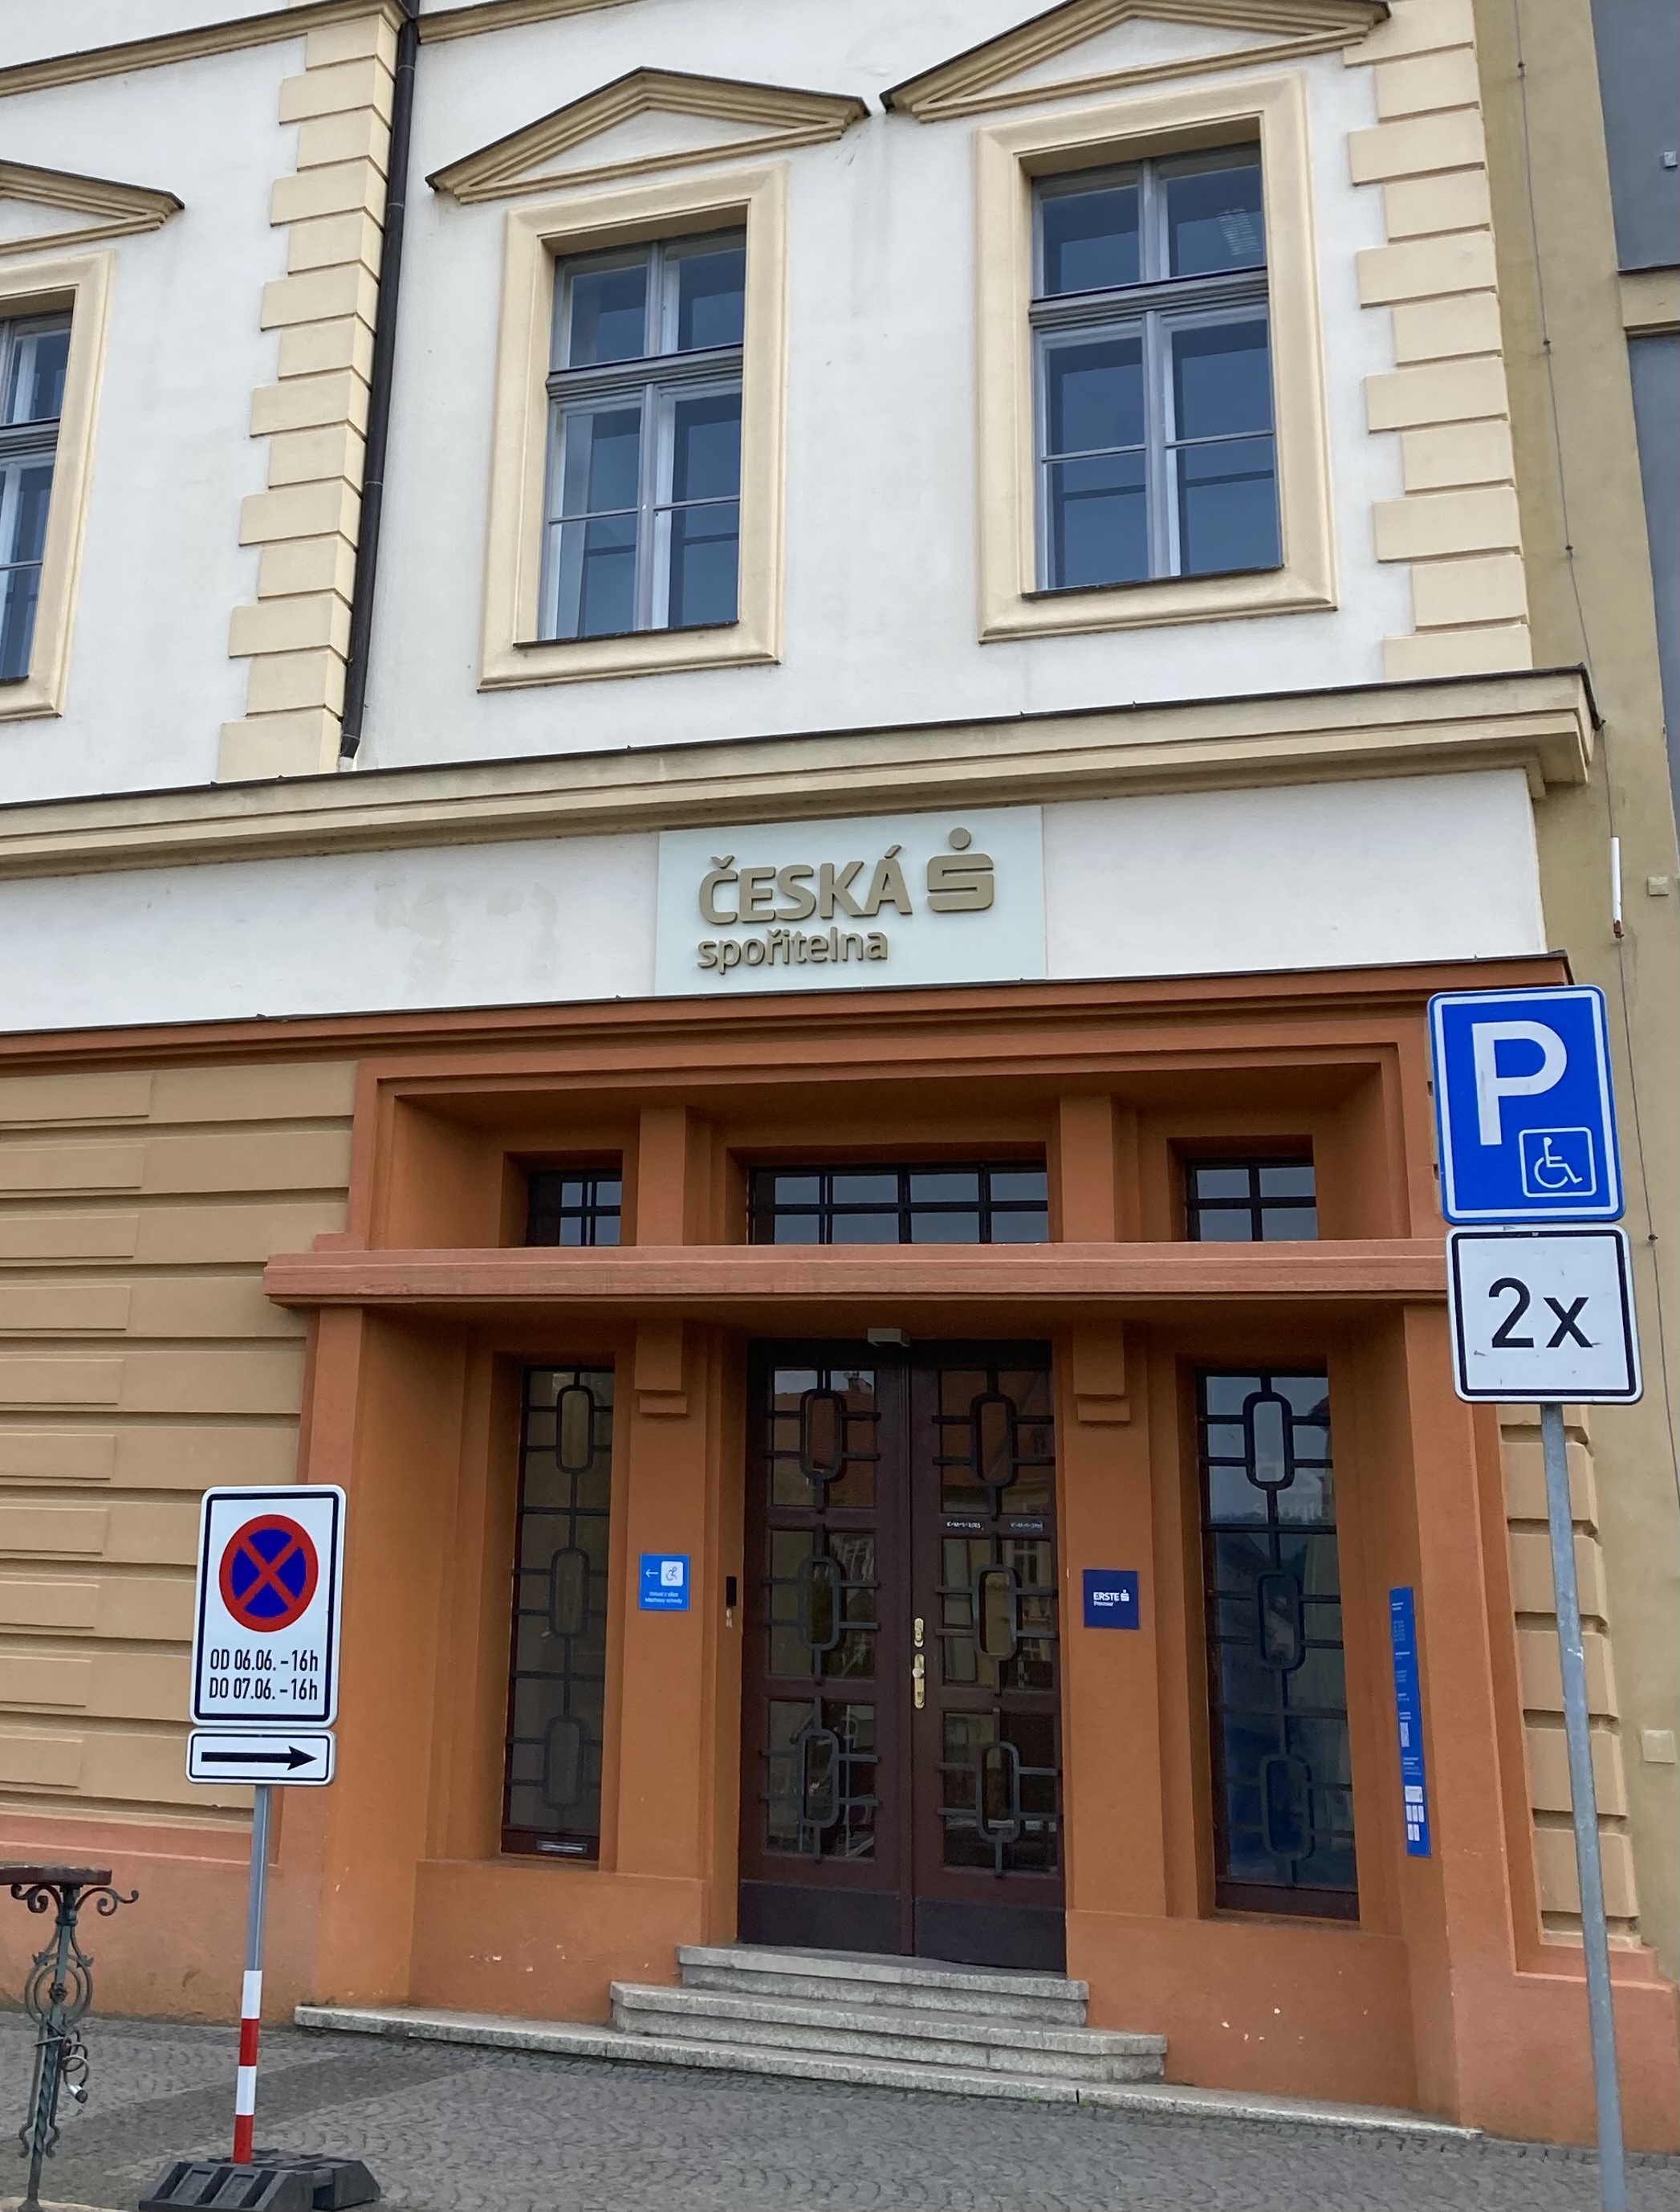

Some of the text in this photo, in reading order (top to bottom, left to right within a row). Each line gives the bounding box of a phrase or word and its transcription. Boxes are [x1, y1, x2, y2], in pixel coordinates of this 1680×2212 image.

[699, 845, 913, 924] ČESKÁ
[698, 927, 889, 976] spořitelna
[1472, 1020, 1567, 1146] P
[1488, 1277, 1594, 1348] 2x
[1093, 1591, 1120, 1602] ERSTE
[210, 1648, 230, 1670] OD
[234, 1648, 276, 1671] 06.06.
[209, 1676, 229, 1698] DO
[233, 1676, 275, 1700] 07.06.
